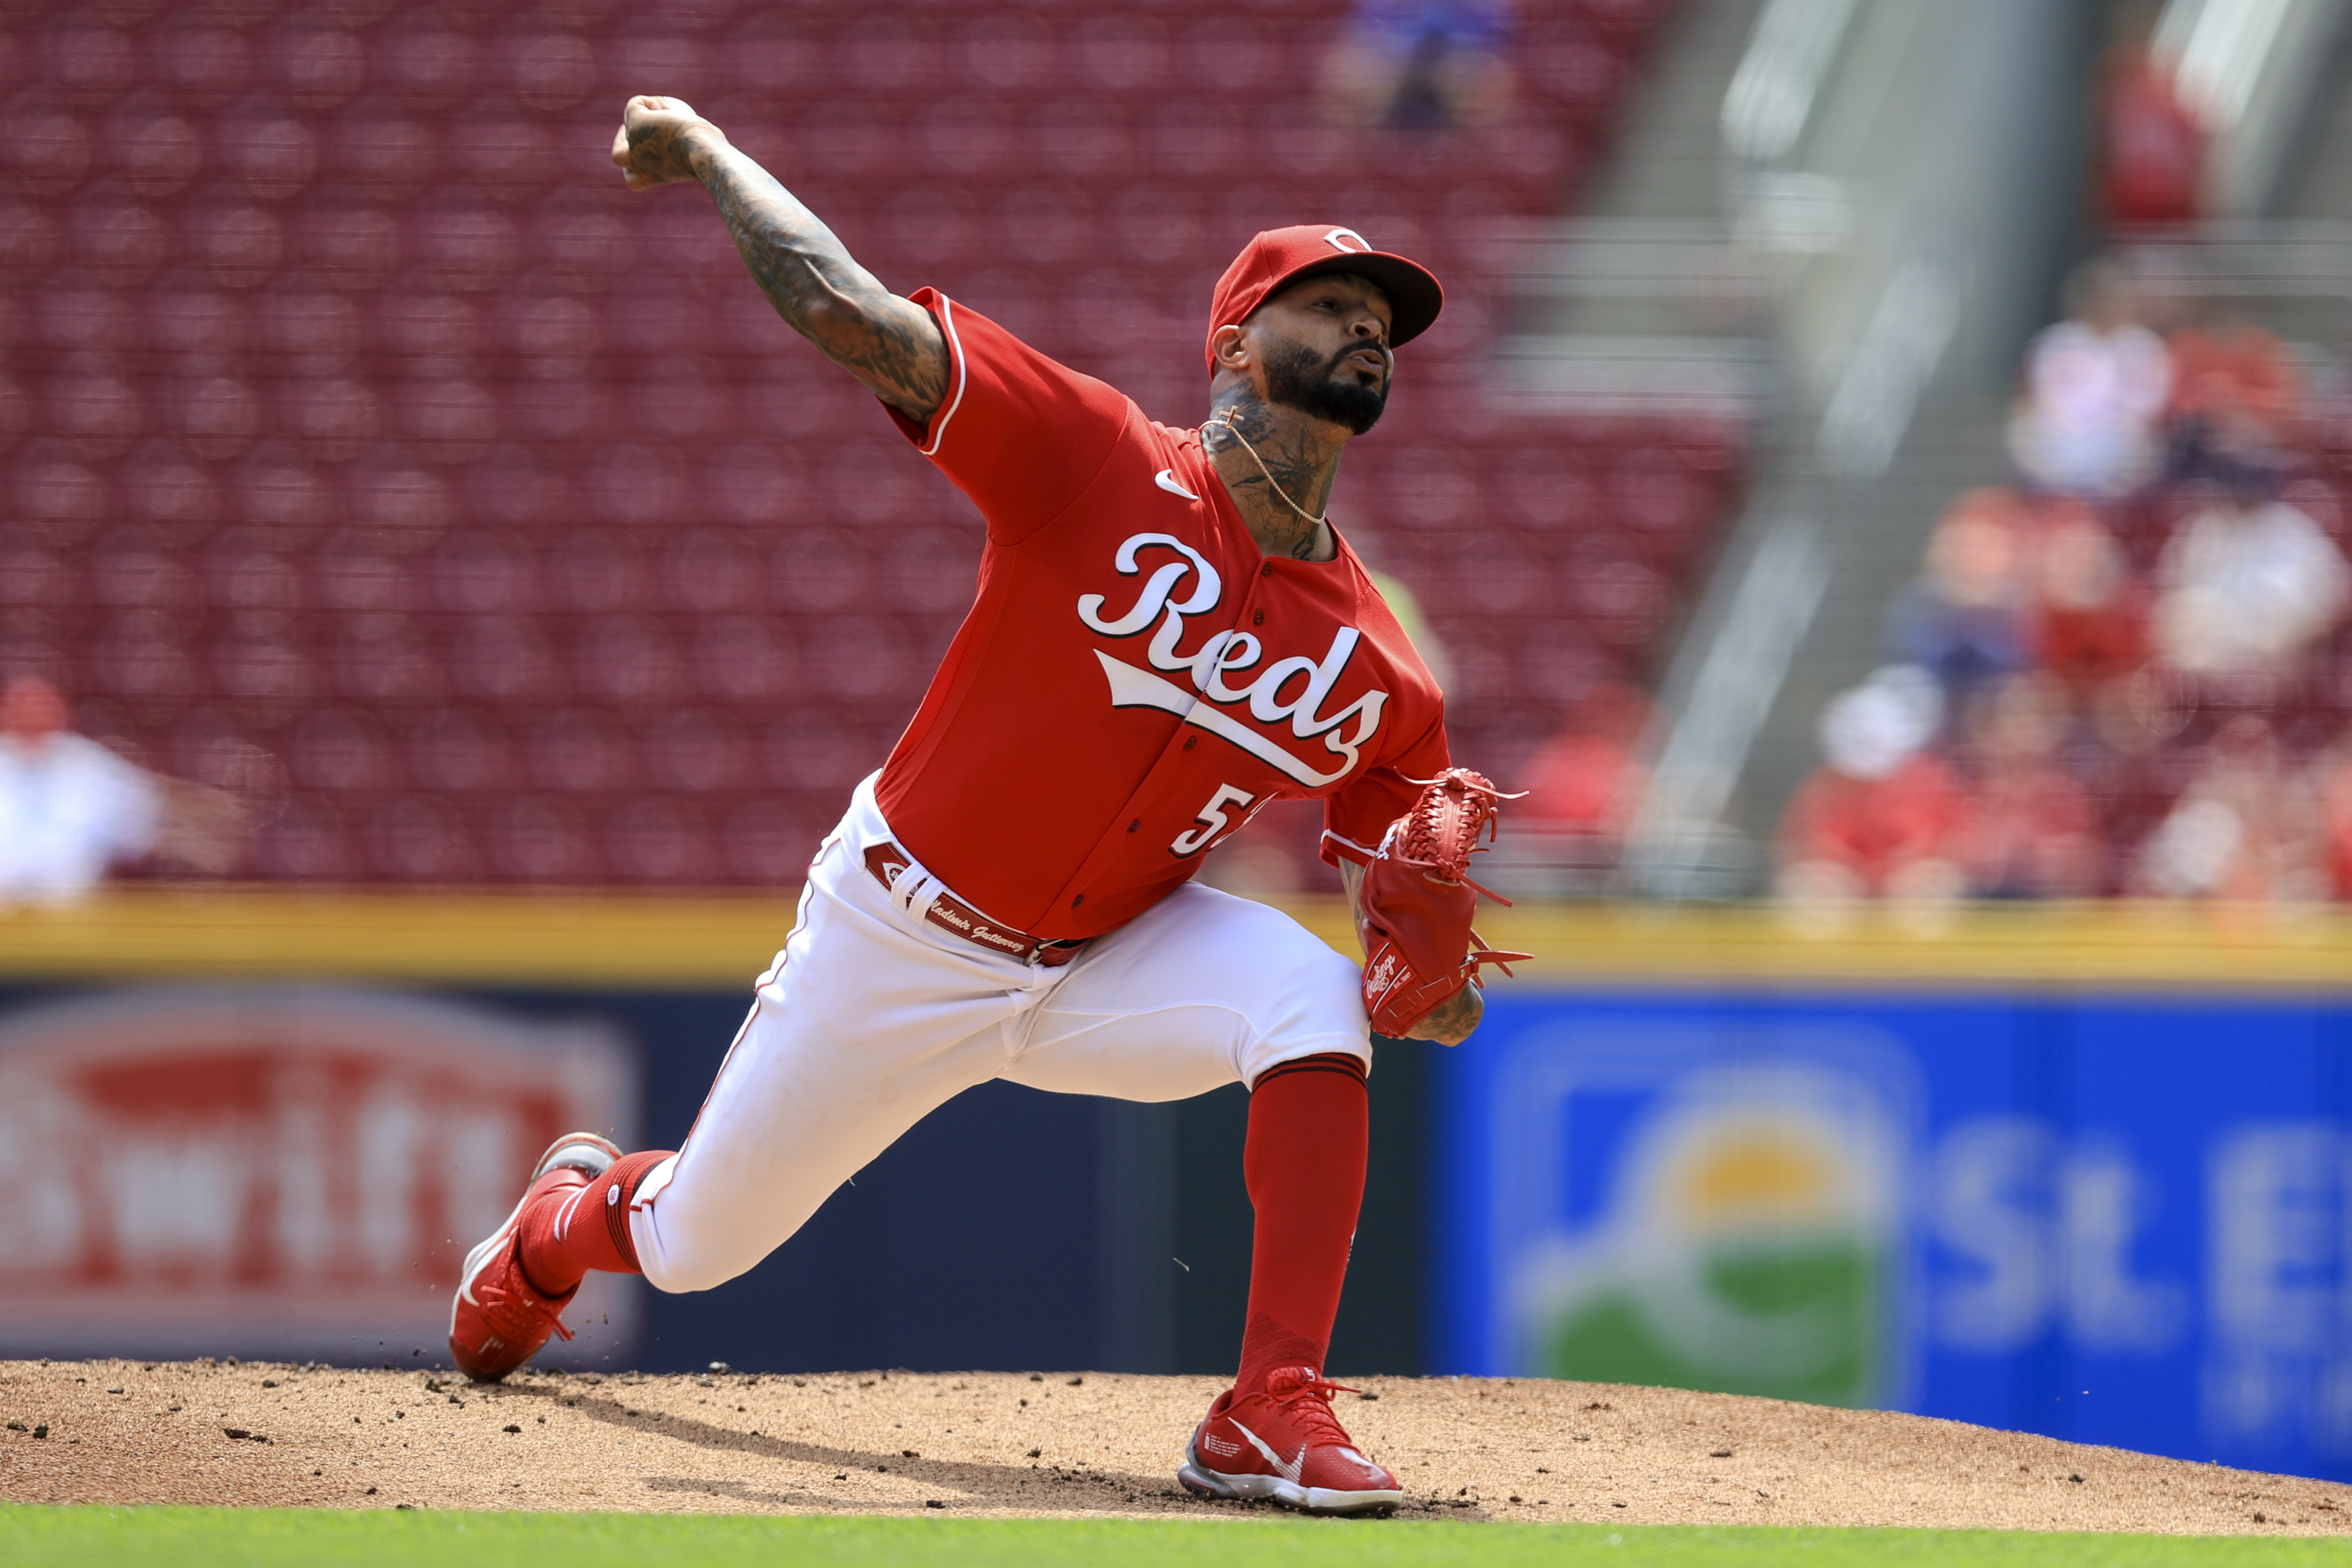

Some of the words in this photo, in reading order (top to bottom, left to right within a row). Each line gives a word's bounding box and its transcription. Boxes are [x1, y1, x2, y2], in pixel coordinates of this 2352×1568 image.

[1078, 533, 1388, 788] Reds
[1167, 782, 1282, 859] 5
[931, 900, 971, 930] ladimir
[971, 926, 1025, 953] Gutierrez
[1367, 954, 1396, 999] Rawlings
